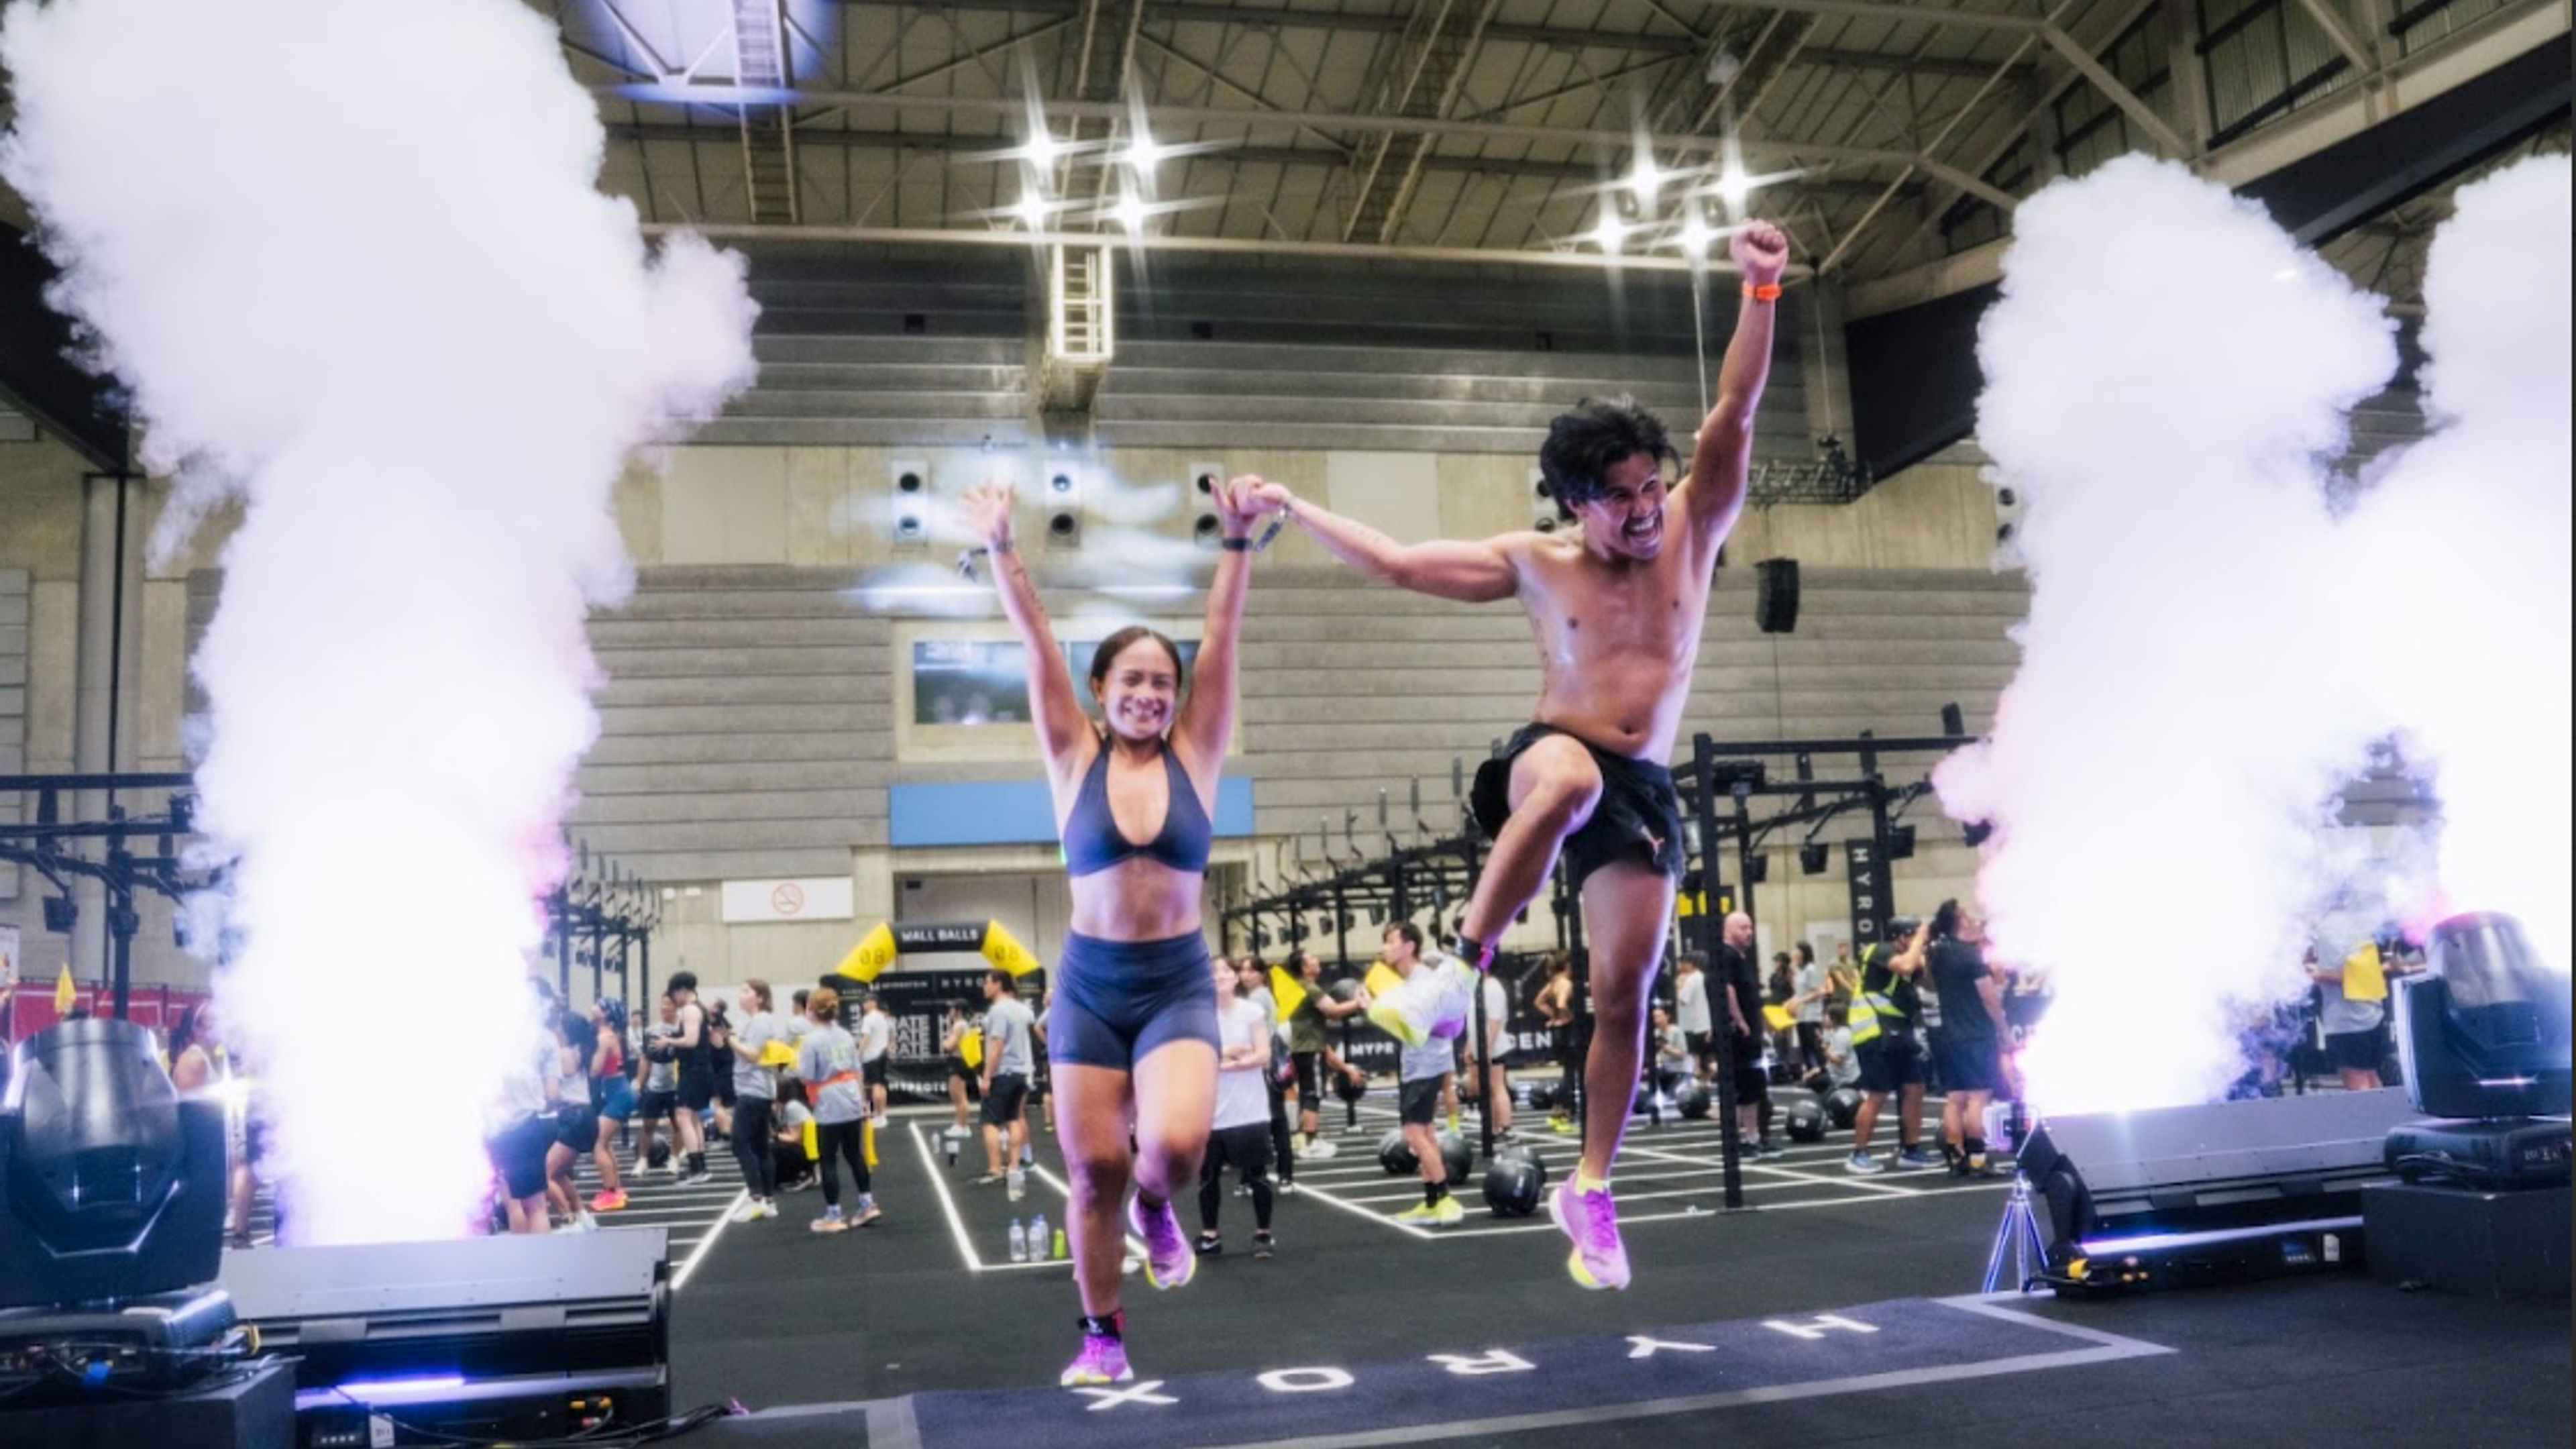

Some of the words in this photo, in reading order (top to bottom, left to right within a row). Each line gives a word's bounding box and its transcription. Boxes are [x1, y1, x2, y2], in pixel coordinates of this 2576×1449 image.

[901, 930, 936, 942] WALL
[938, 928, 979, 941] BALLS
[859, 948, 885, 965] 08
[994, 945, 1021, 961] 08
